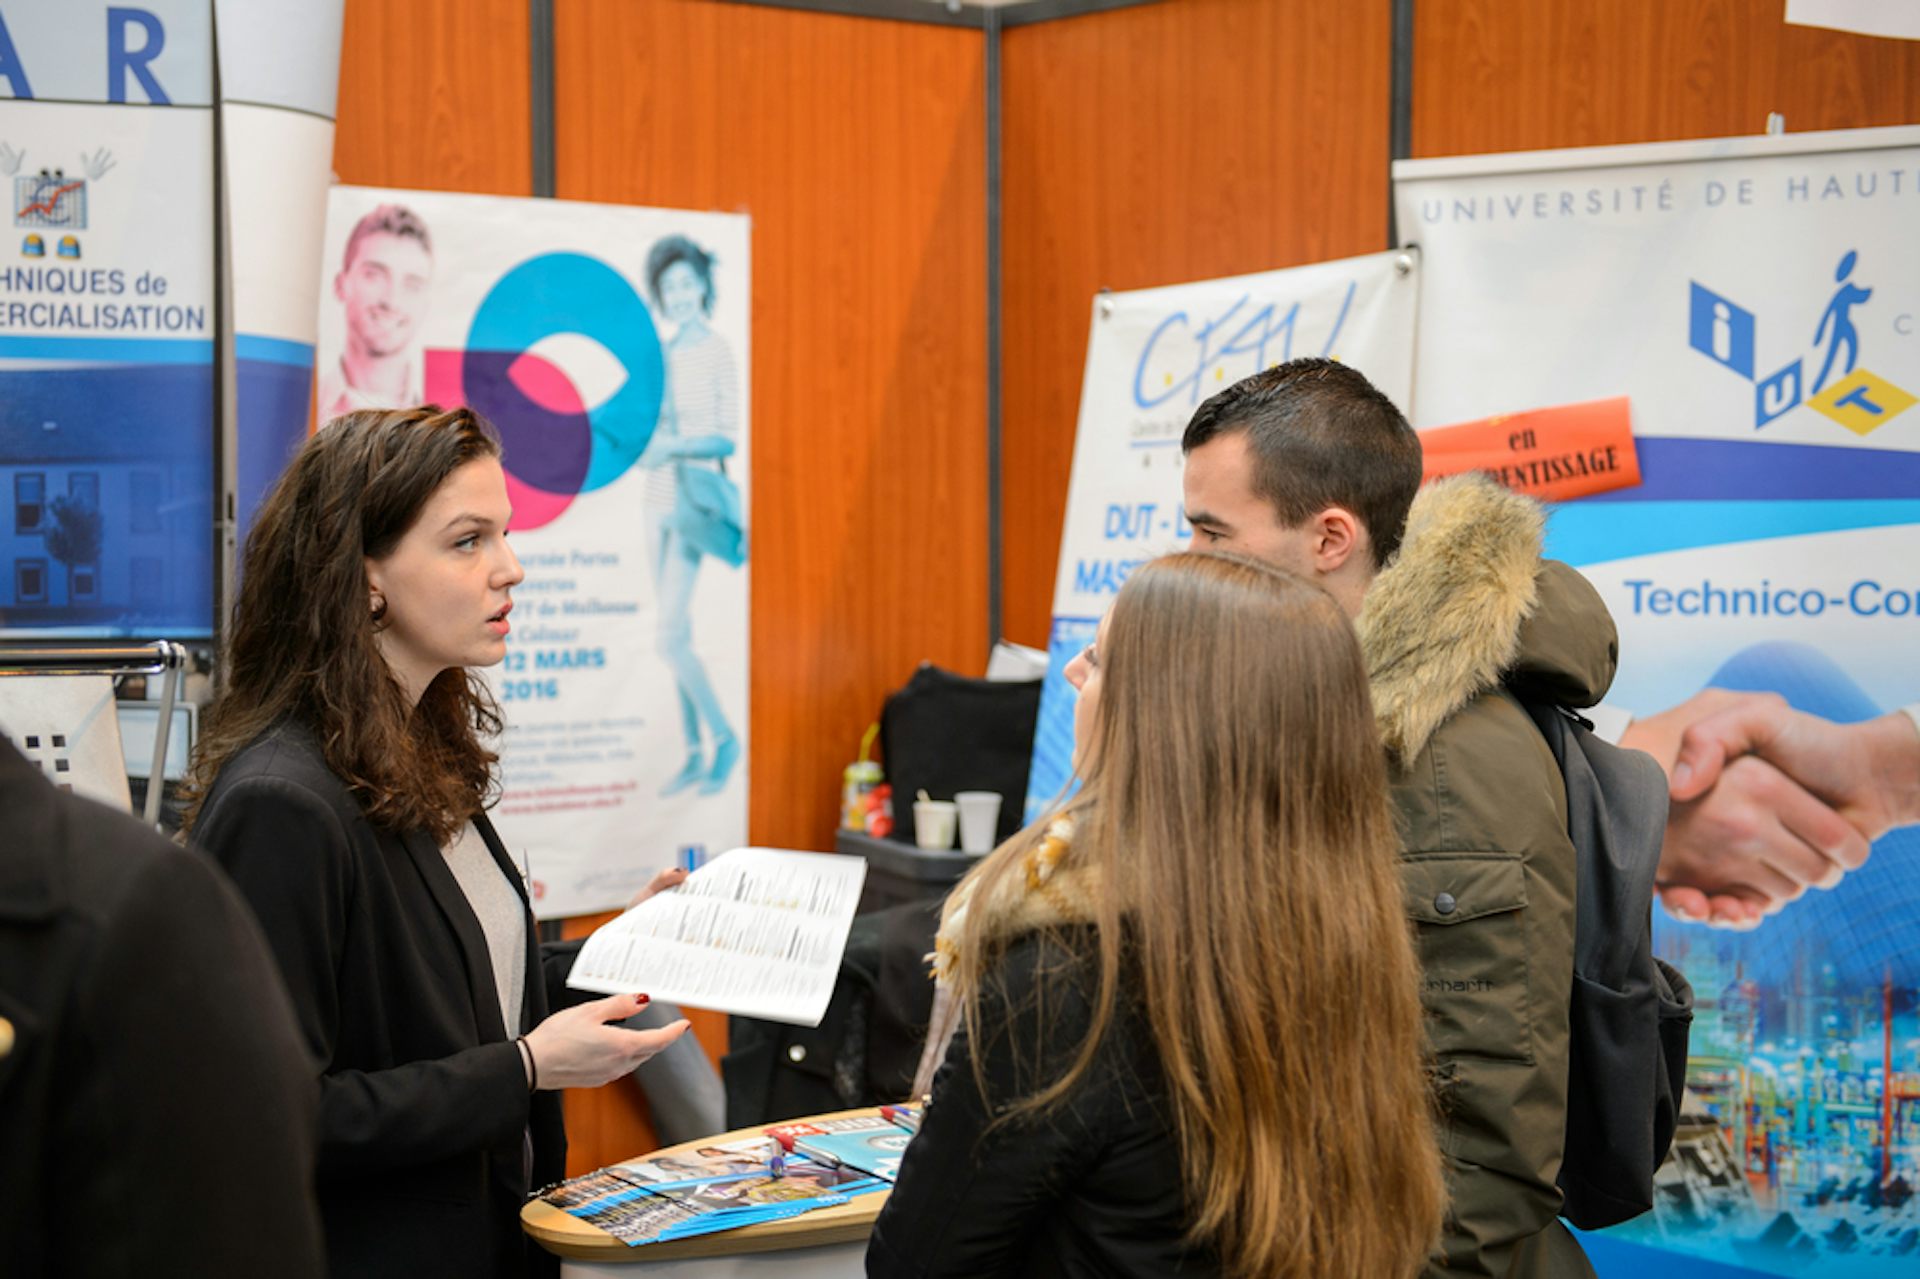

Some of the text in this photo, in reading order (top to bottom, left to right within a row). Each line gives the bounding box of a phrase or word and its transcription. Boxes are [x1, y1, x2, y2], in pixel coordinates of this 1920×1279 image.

[1423, 169, 1920, 223] UNIVERSITÉ DE HAUT
[135, 271, 167, 295] de
[1508, 429, 1537, 451] en
[1104, 503, 1157, 539] DUT
[1624, 579, 1920, 616] Technico-Co
[535, 648, 606, 669] MARS
[502, 679, 558, 701] 2016
